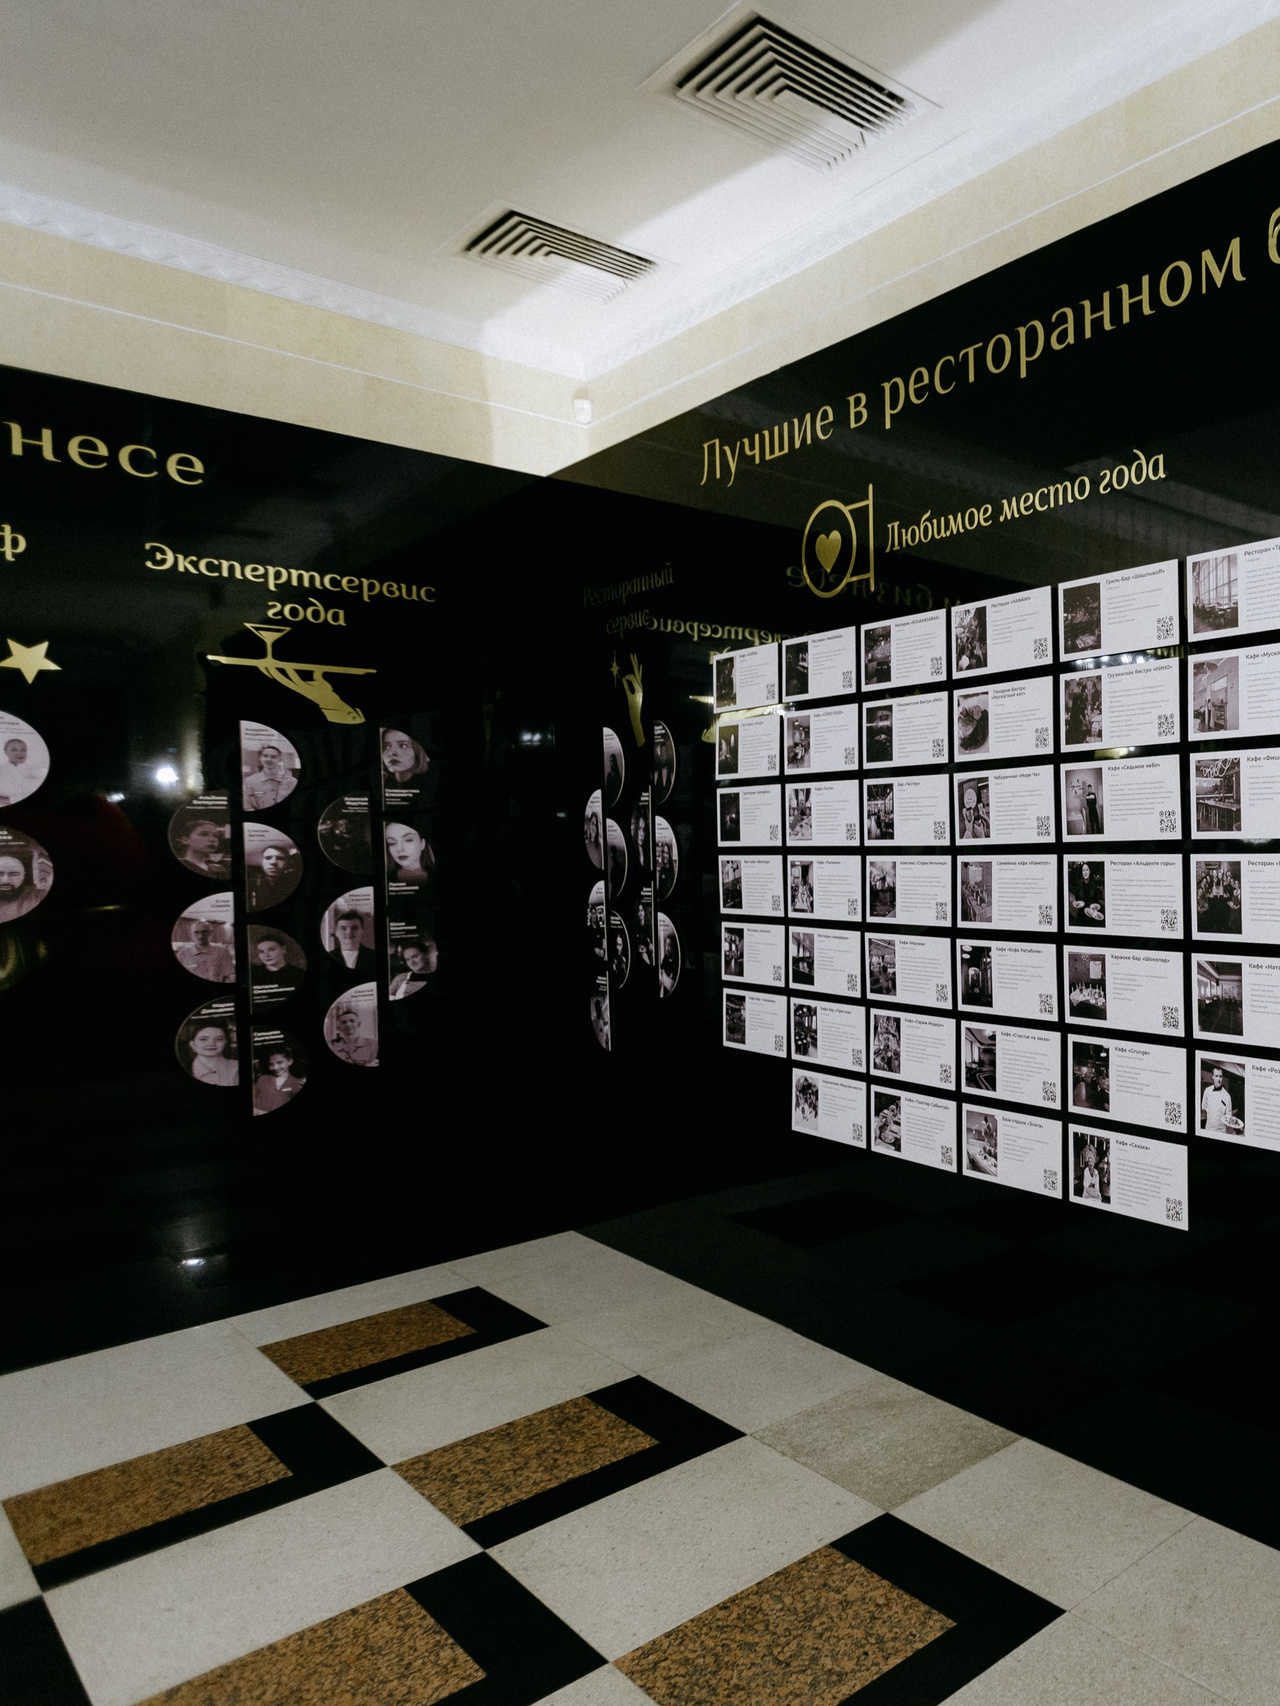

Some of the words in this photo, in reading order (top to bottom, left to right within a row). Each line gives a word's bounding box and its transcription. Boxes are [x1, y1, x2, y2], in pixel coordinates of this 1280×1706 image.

[700, 405, 834, 487] Лучшие
[847, 392, 868, 429] в
[884, 235, 1246, 430] ресторанном
[885, 503, 993, 552] Любимое
[998, 476, 1091, 522] место
[1098, 448, 1167, 495] года
[1243, 547, 1272, 557] Ресторан
[144, 542, 436, 603] Экспертсервис
[584, 562, 674, 608] Ресторанный
[266, 600, 347, 627] года
[606, 609, 650, 638] сервис
[1247, 859, 1275, 868] Ресторан
